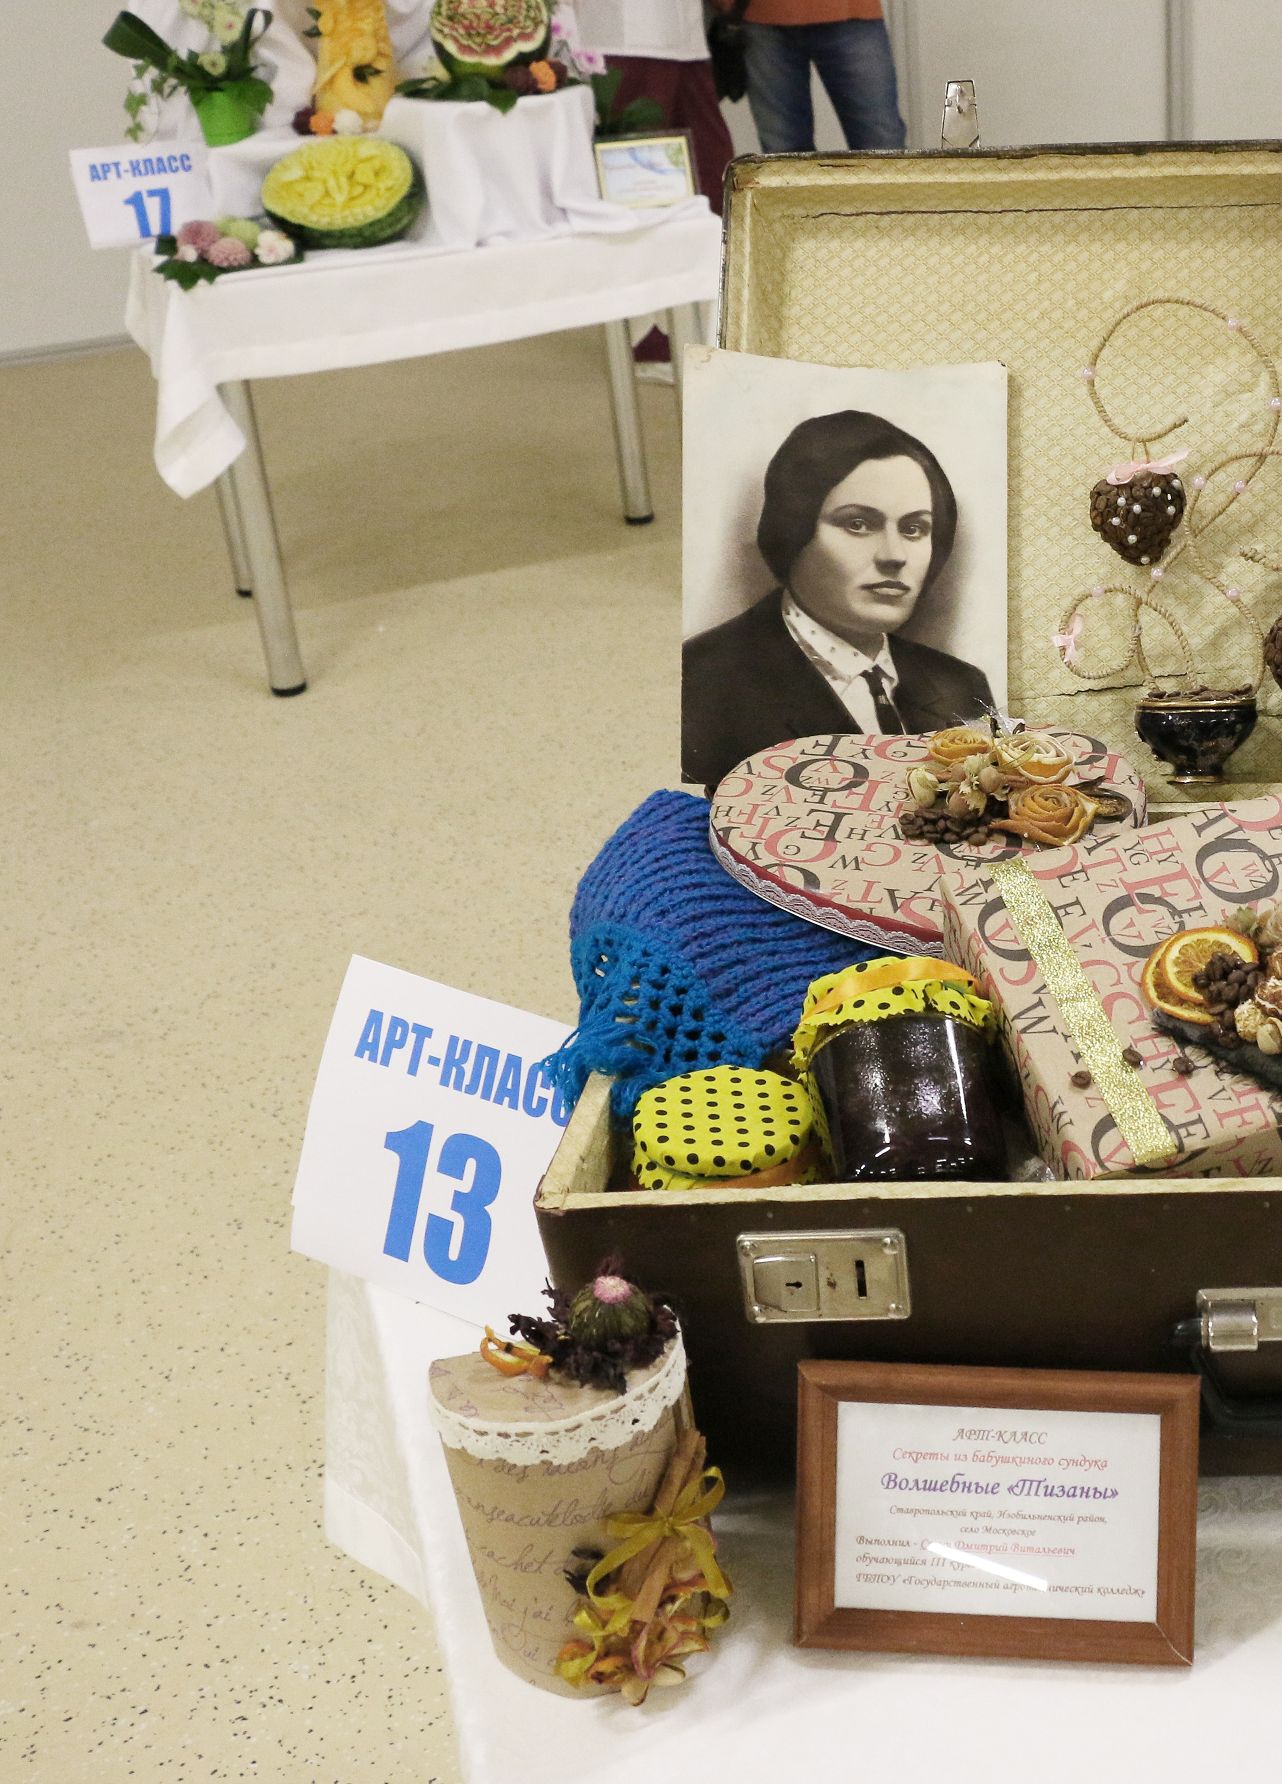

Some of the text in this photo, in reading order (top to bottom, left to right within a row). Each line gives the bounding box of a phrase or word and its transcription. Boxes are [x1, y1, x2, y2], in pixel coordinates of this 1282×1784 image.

[89, 153, 192, 182] АРТ-КЛАСС
[123, 188, 172, 238] 17
[382, 1119, 502, 1286] 13
[952, 1427, 1048, 1445] АРТ-КЛАСС
[892, 1448, 1108, 1470] Секреты из бабушкиного сундука
[881, 1472, 1119, 1500] Волшебные «Тизаны»
